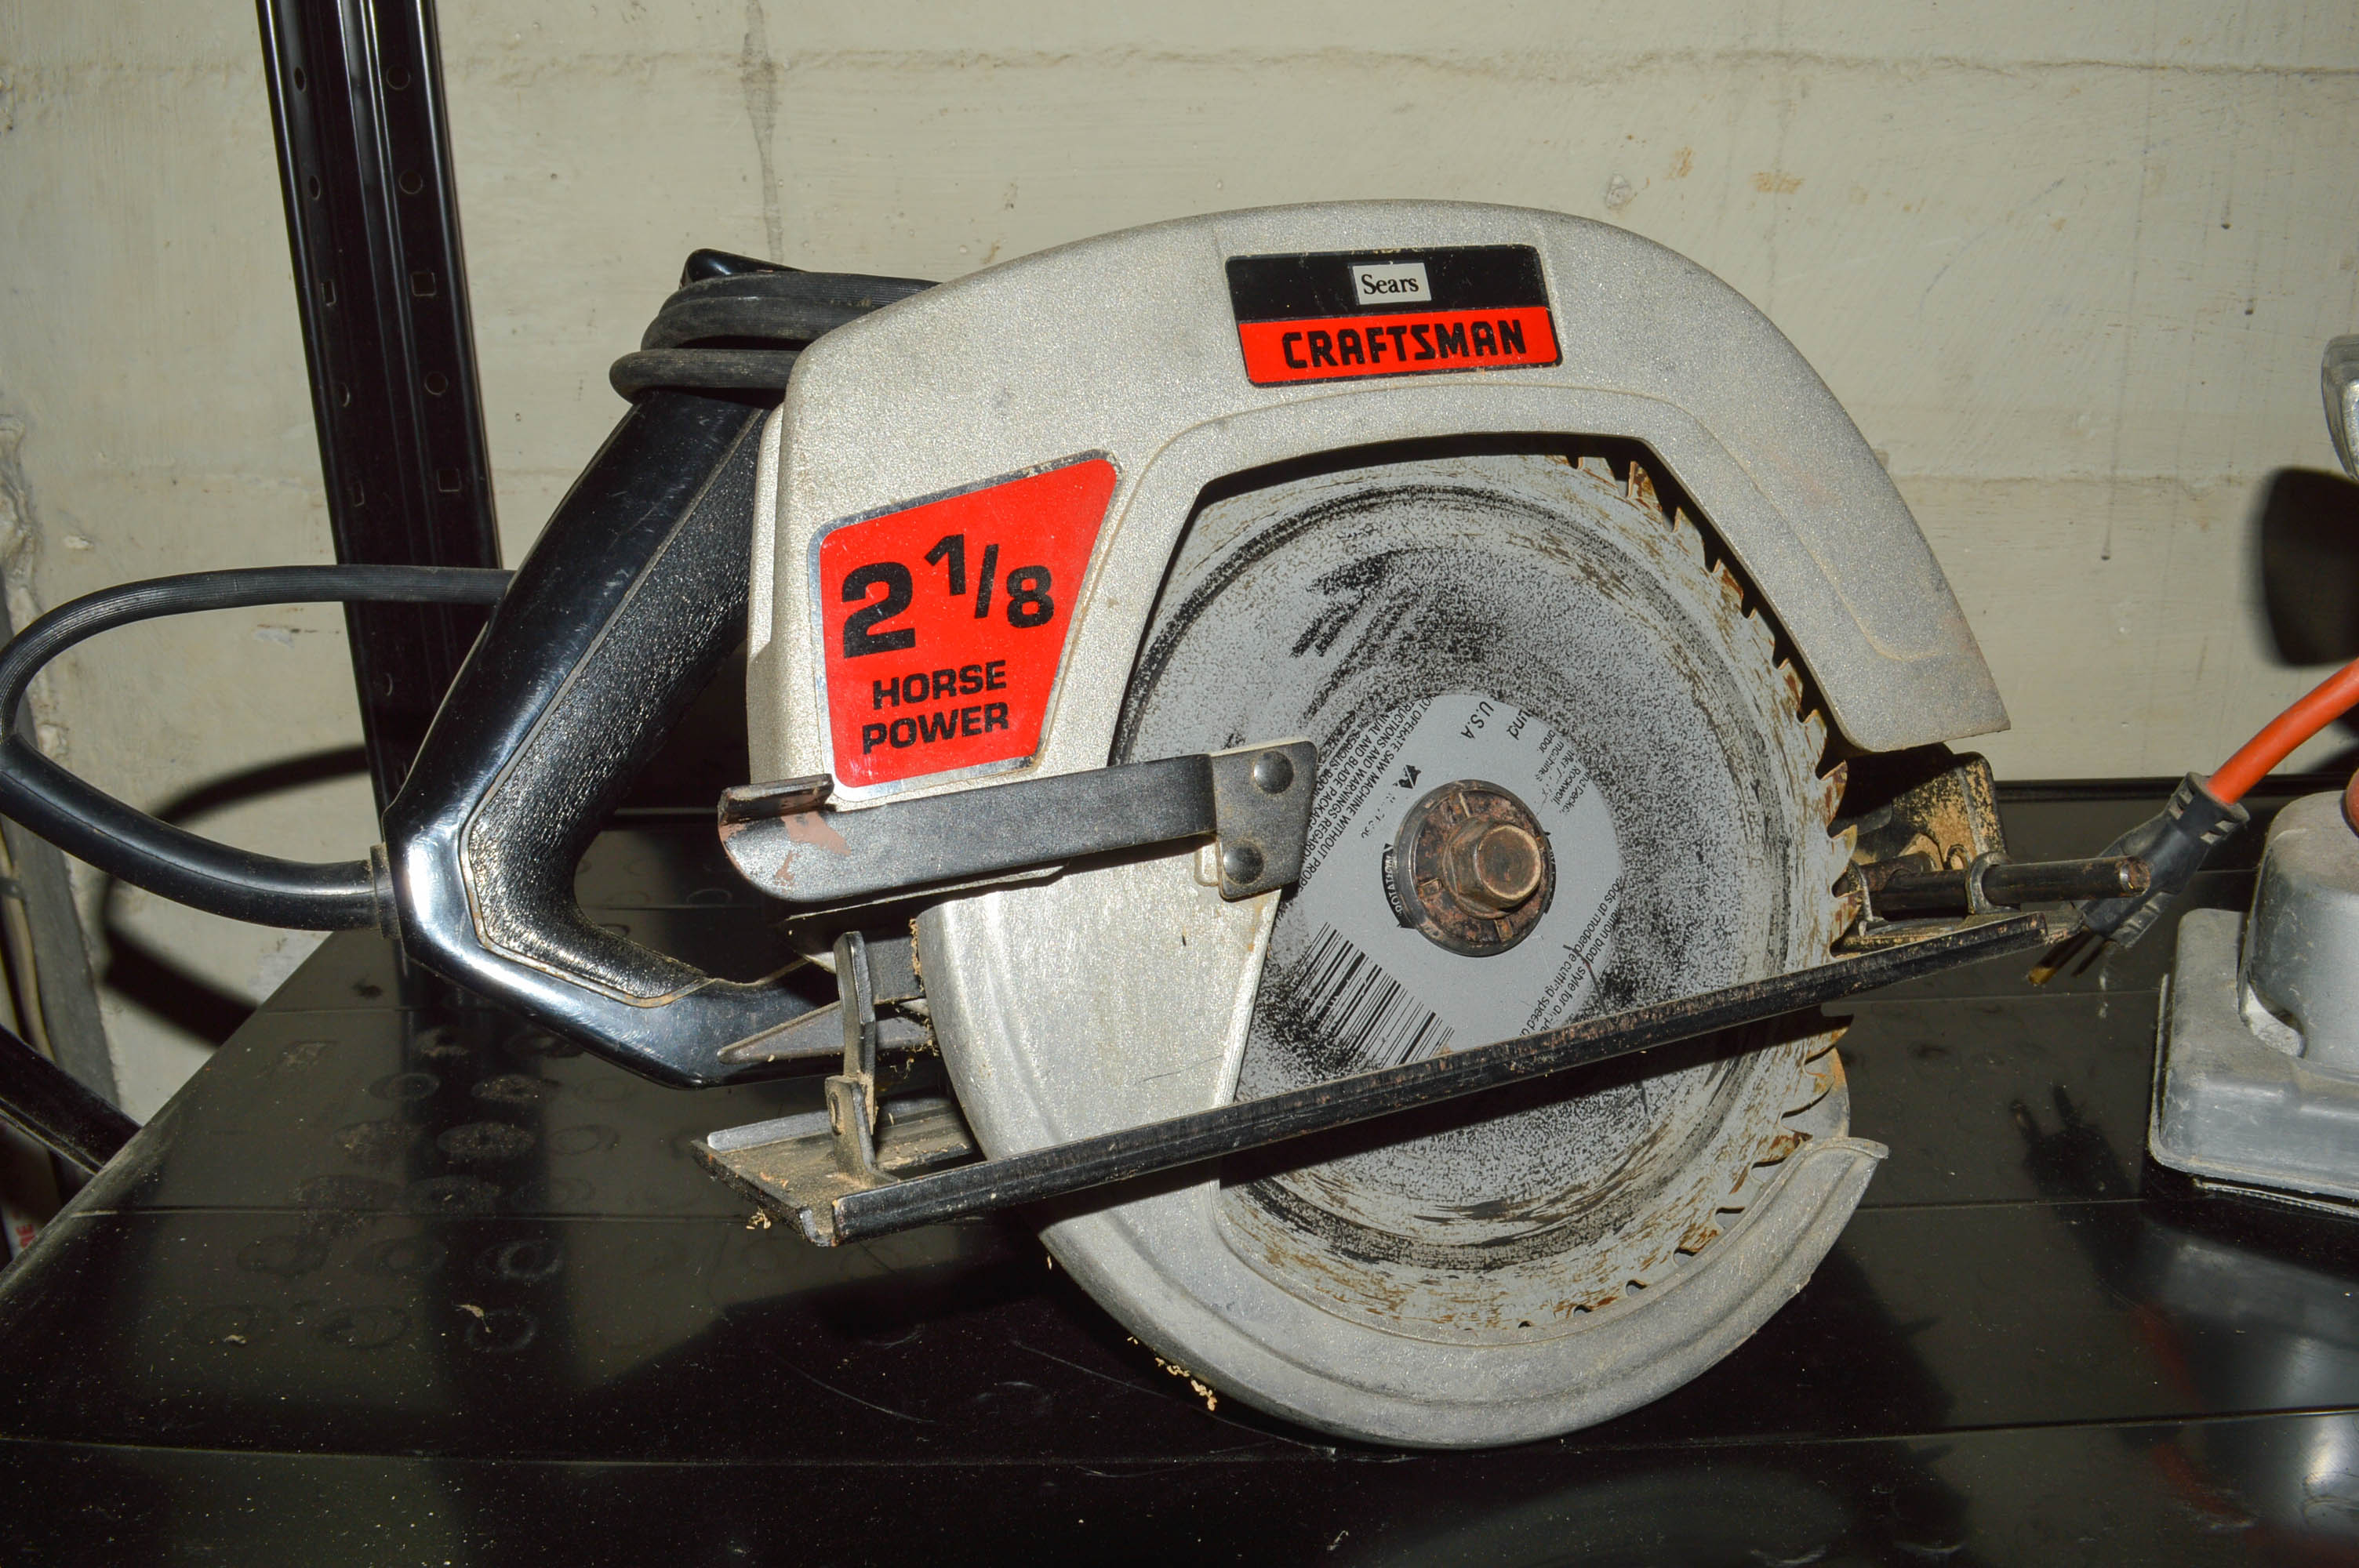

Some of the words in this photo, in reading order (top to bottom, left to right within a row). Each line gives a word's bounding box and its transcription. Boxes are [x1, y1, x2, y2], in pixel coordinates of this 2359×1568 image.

[1363, 273, 1419, 296] Sears
[1281, 320, 1527, 370] CRAFTSMAN
[872, 659, 1007, 710] HORSE
[862, 701, 1009, 755] POWER
[1352, 733, 1373, 758] AND
[1332, 754, 1359, 789] BLADE
[1361, 745, 1382, 769] AND
[1373, 749, 1395, 775] SAW
[1326, 765, 1368, 820] WARNINGS
[1345, 770, 1380, 816] MACHINE
[1315, 812, 1351, 860] WITHOUT
[1563, 964, 1589, 993] style
[1555, 989, 1574, 1008] for
